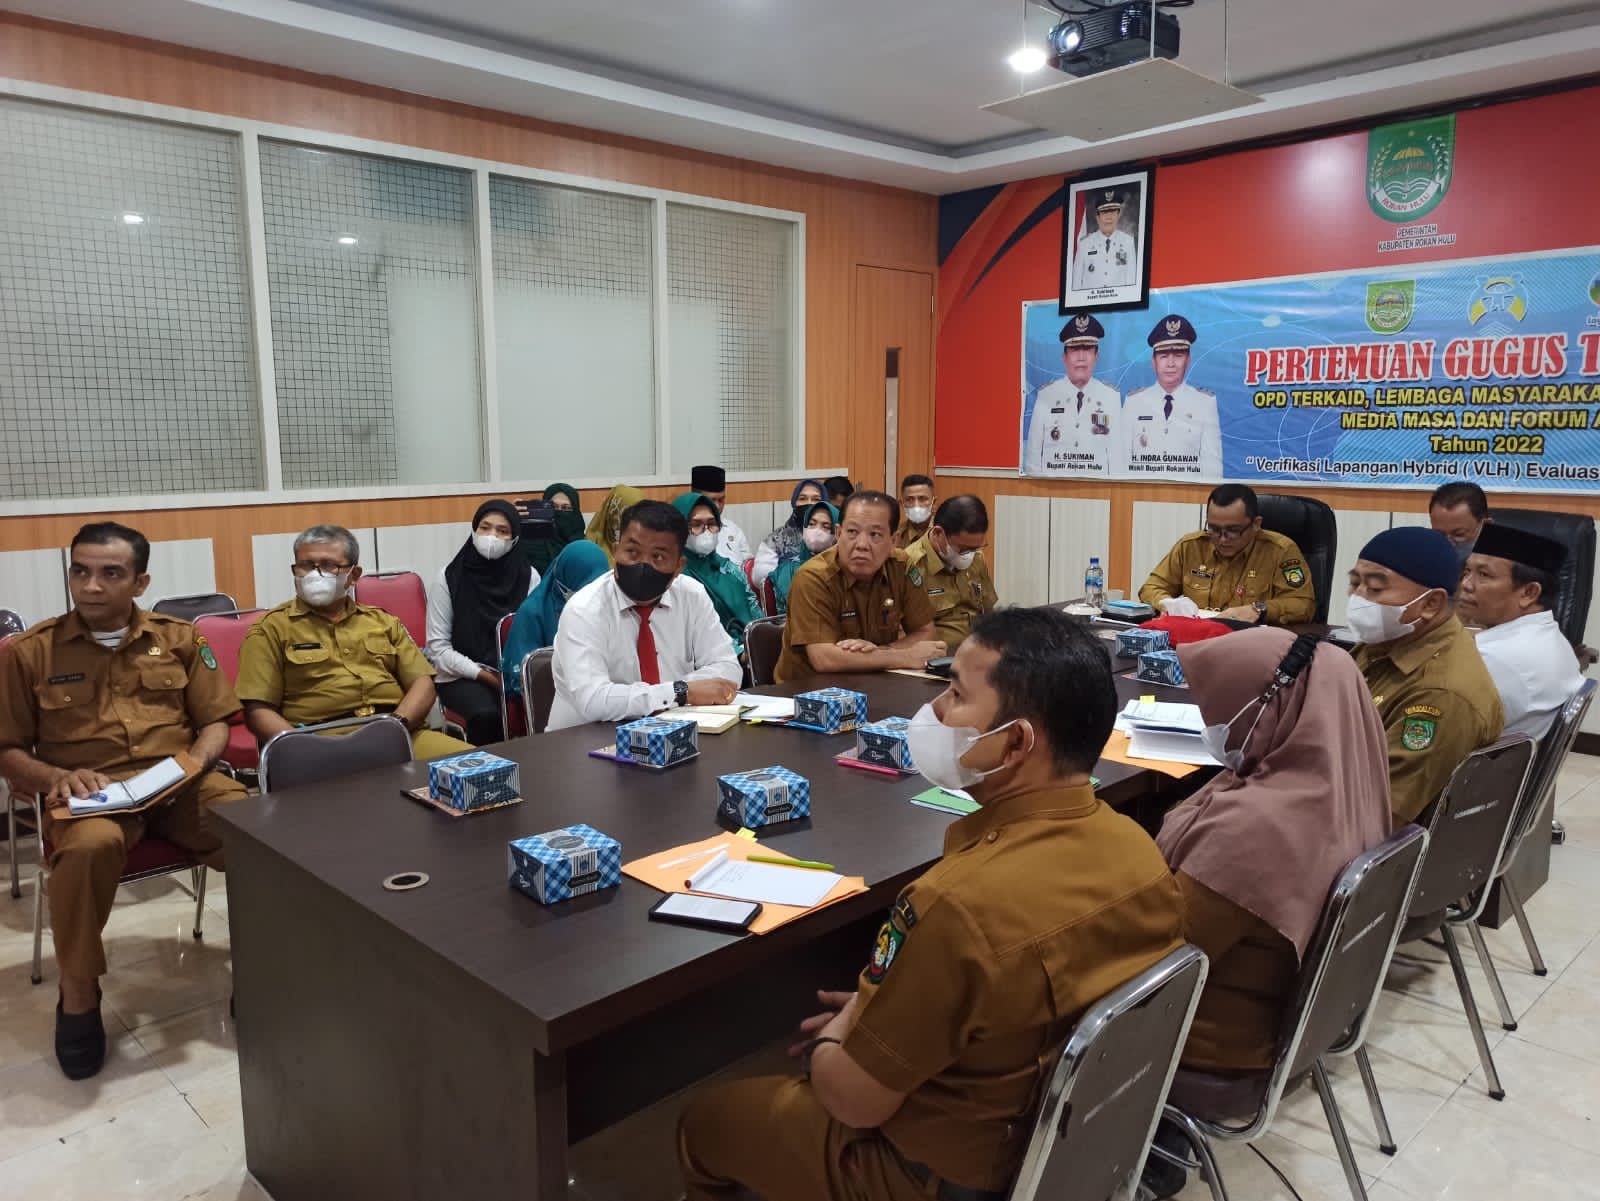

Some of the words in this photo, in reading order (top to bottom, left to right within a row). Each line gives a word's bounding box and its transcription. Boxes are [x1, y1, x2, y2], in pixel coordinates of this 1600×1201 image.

[1397, 225, 1437, 238] PEMERINTAH
[1378, 239, 1415, 252] KABUPATEN
[1415, 237, 1437, 248] ROKAN
[1437, 234, 1456, 245] HULU
[1246, 341, 1434, 384] PERTEMUAN
[1444, 335, 1566, 378] GUGUS
[1254, 391, 1287, 407] OPD
[1292, 389, 1370, 408] TERKAID,
[1375, 387, 1465, 405] LEMBAGA
[1471, 384, 1600, 404] MASYARAKA
[1342, 412, 1398, 428] MEDIA
[1403, 412, 1457, 428] MASA
[1462, 411, 1504, 428] DAN
[1510, 411, 1588, 428] FORUM
[1429, 436, 1488, 453] Tahun
[1493, 436, 1544, 453] 2022
[1063, 452, 1095, 461] SUKIMAN
[1140, 454, 1161, 462] INDRA
[1162, 454, 1199, 463] GUNAWAN
[1325, 458, 1398, 476] Lapangan
[1403, 461, 1458, 479] Hybrid
[1526, 462, 1600, 479] Evaluas
